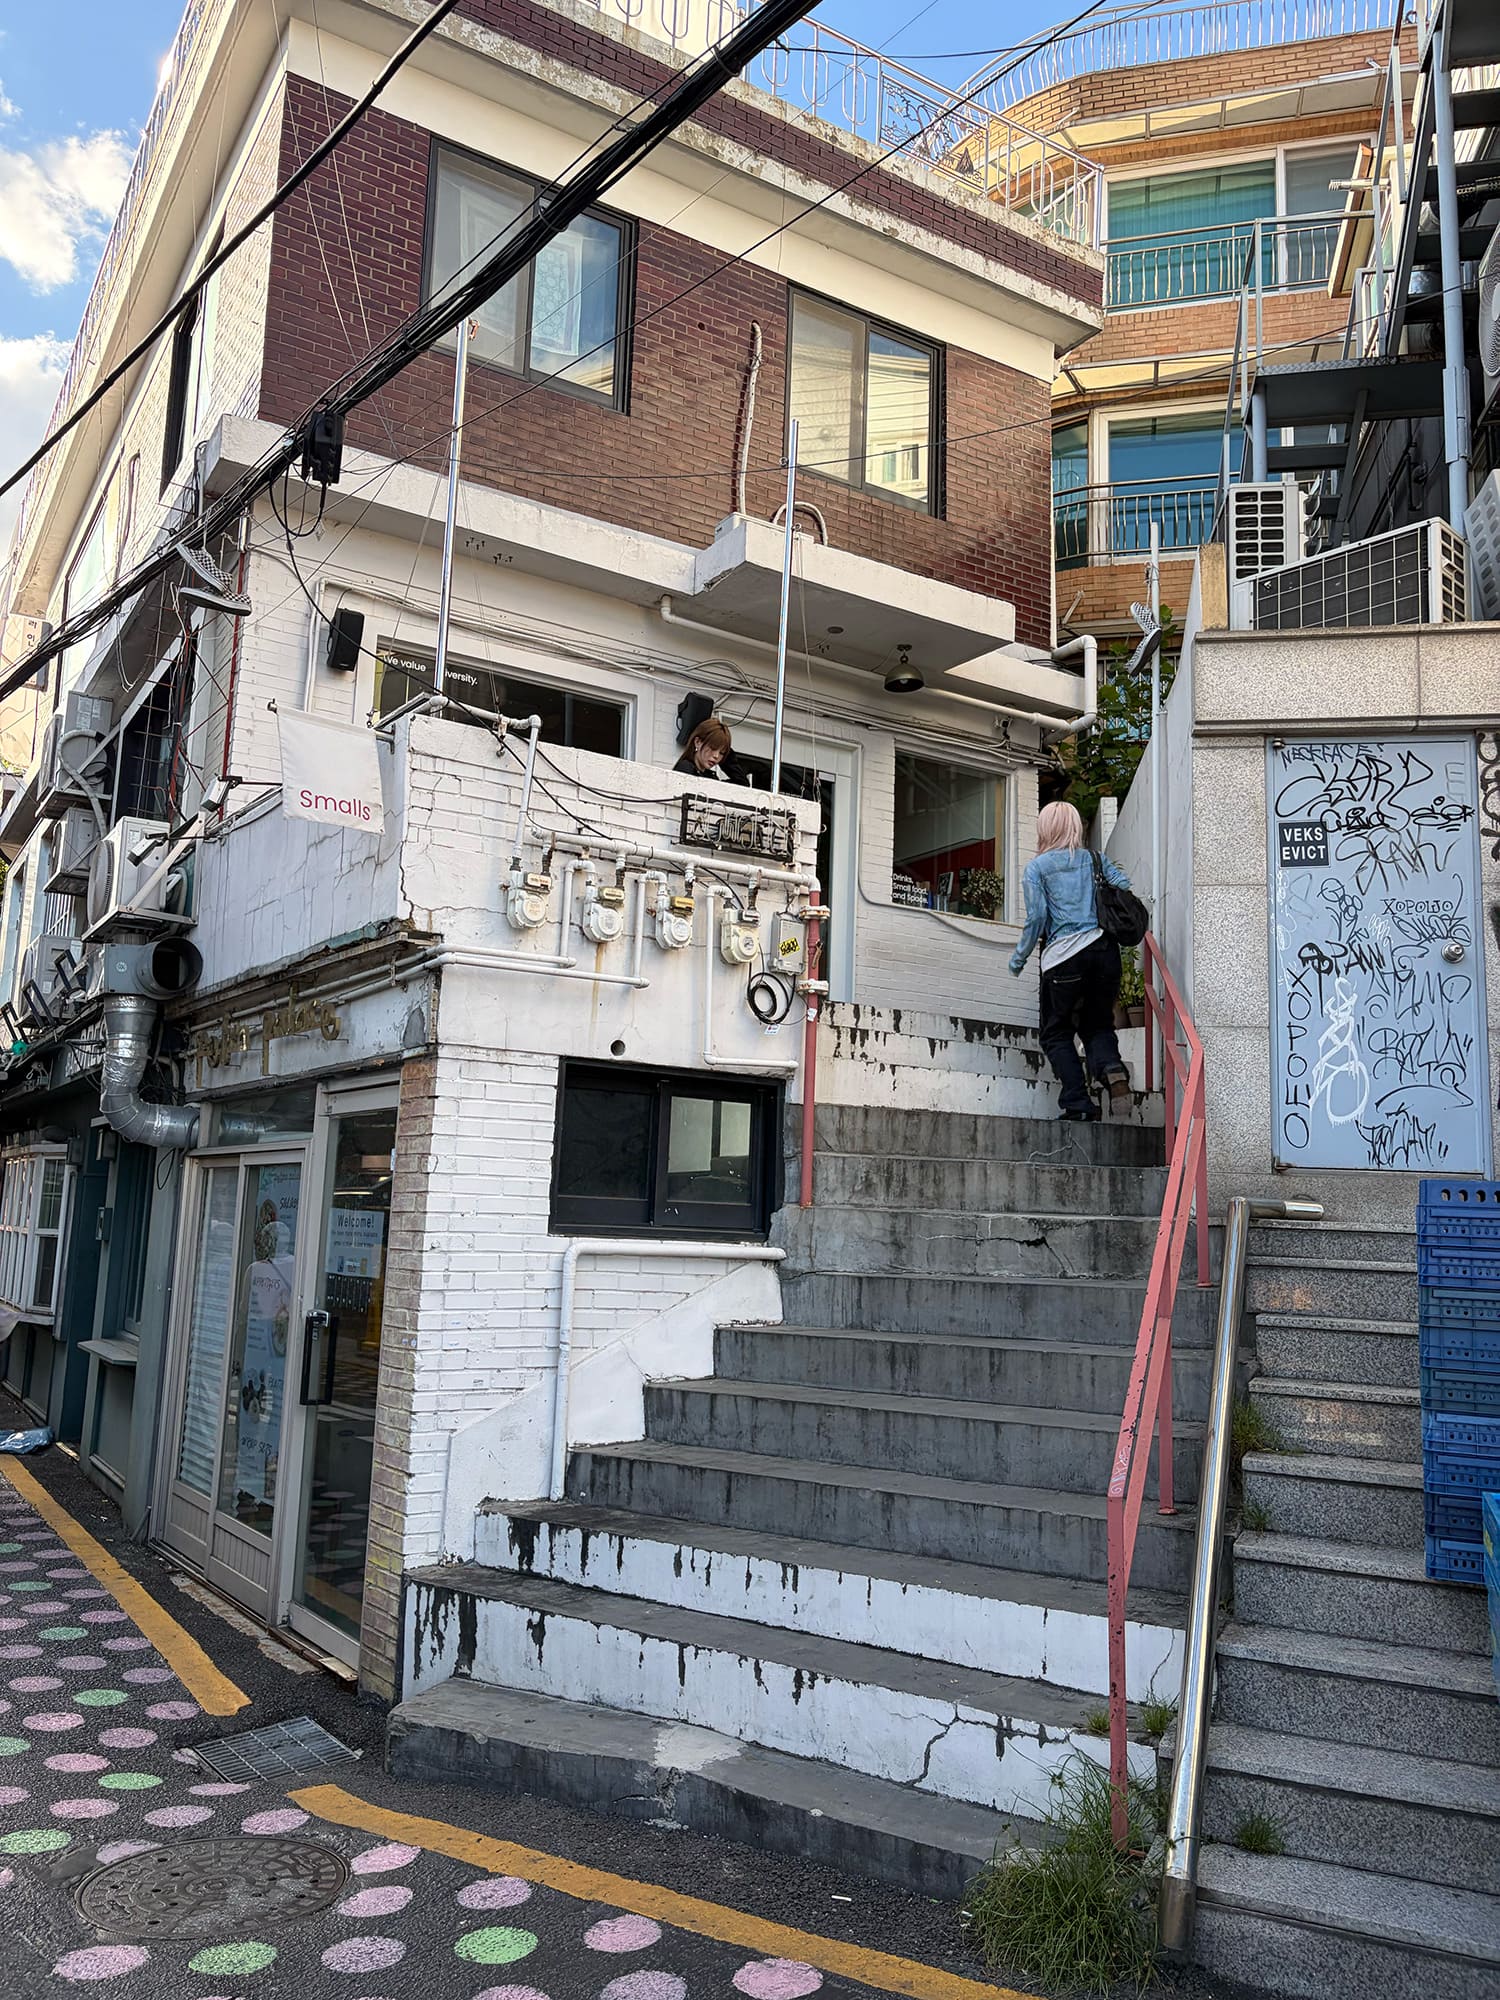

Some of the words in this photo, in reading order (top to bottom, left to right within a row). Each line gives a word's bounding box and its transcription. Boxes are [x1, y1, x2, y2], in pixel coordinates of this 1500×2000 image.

[383, 655, 399, 665] We
[400, 660, 427, 672] value
[444, 667, 478, 685] iversity.
[300, 789, 371, 821] Smalls
[1284, 827, 1324, 842] VEKS
[1282, 845, 1326, 861] EVICT
[892, 882, 911, 892] Small
[892, 892, 906, 900] and
[336, 1214, 375, 1229] Welcome!
